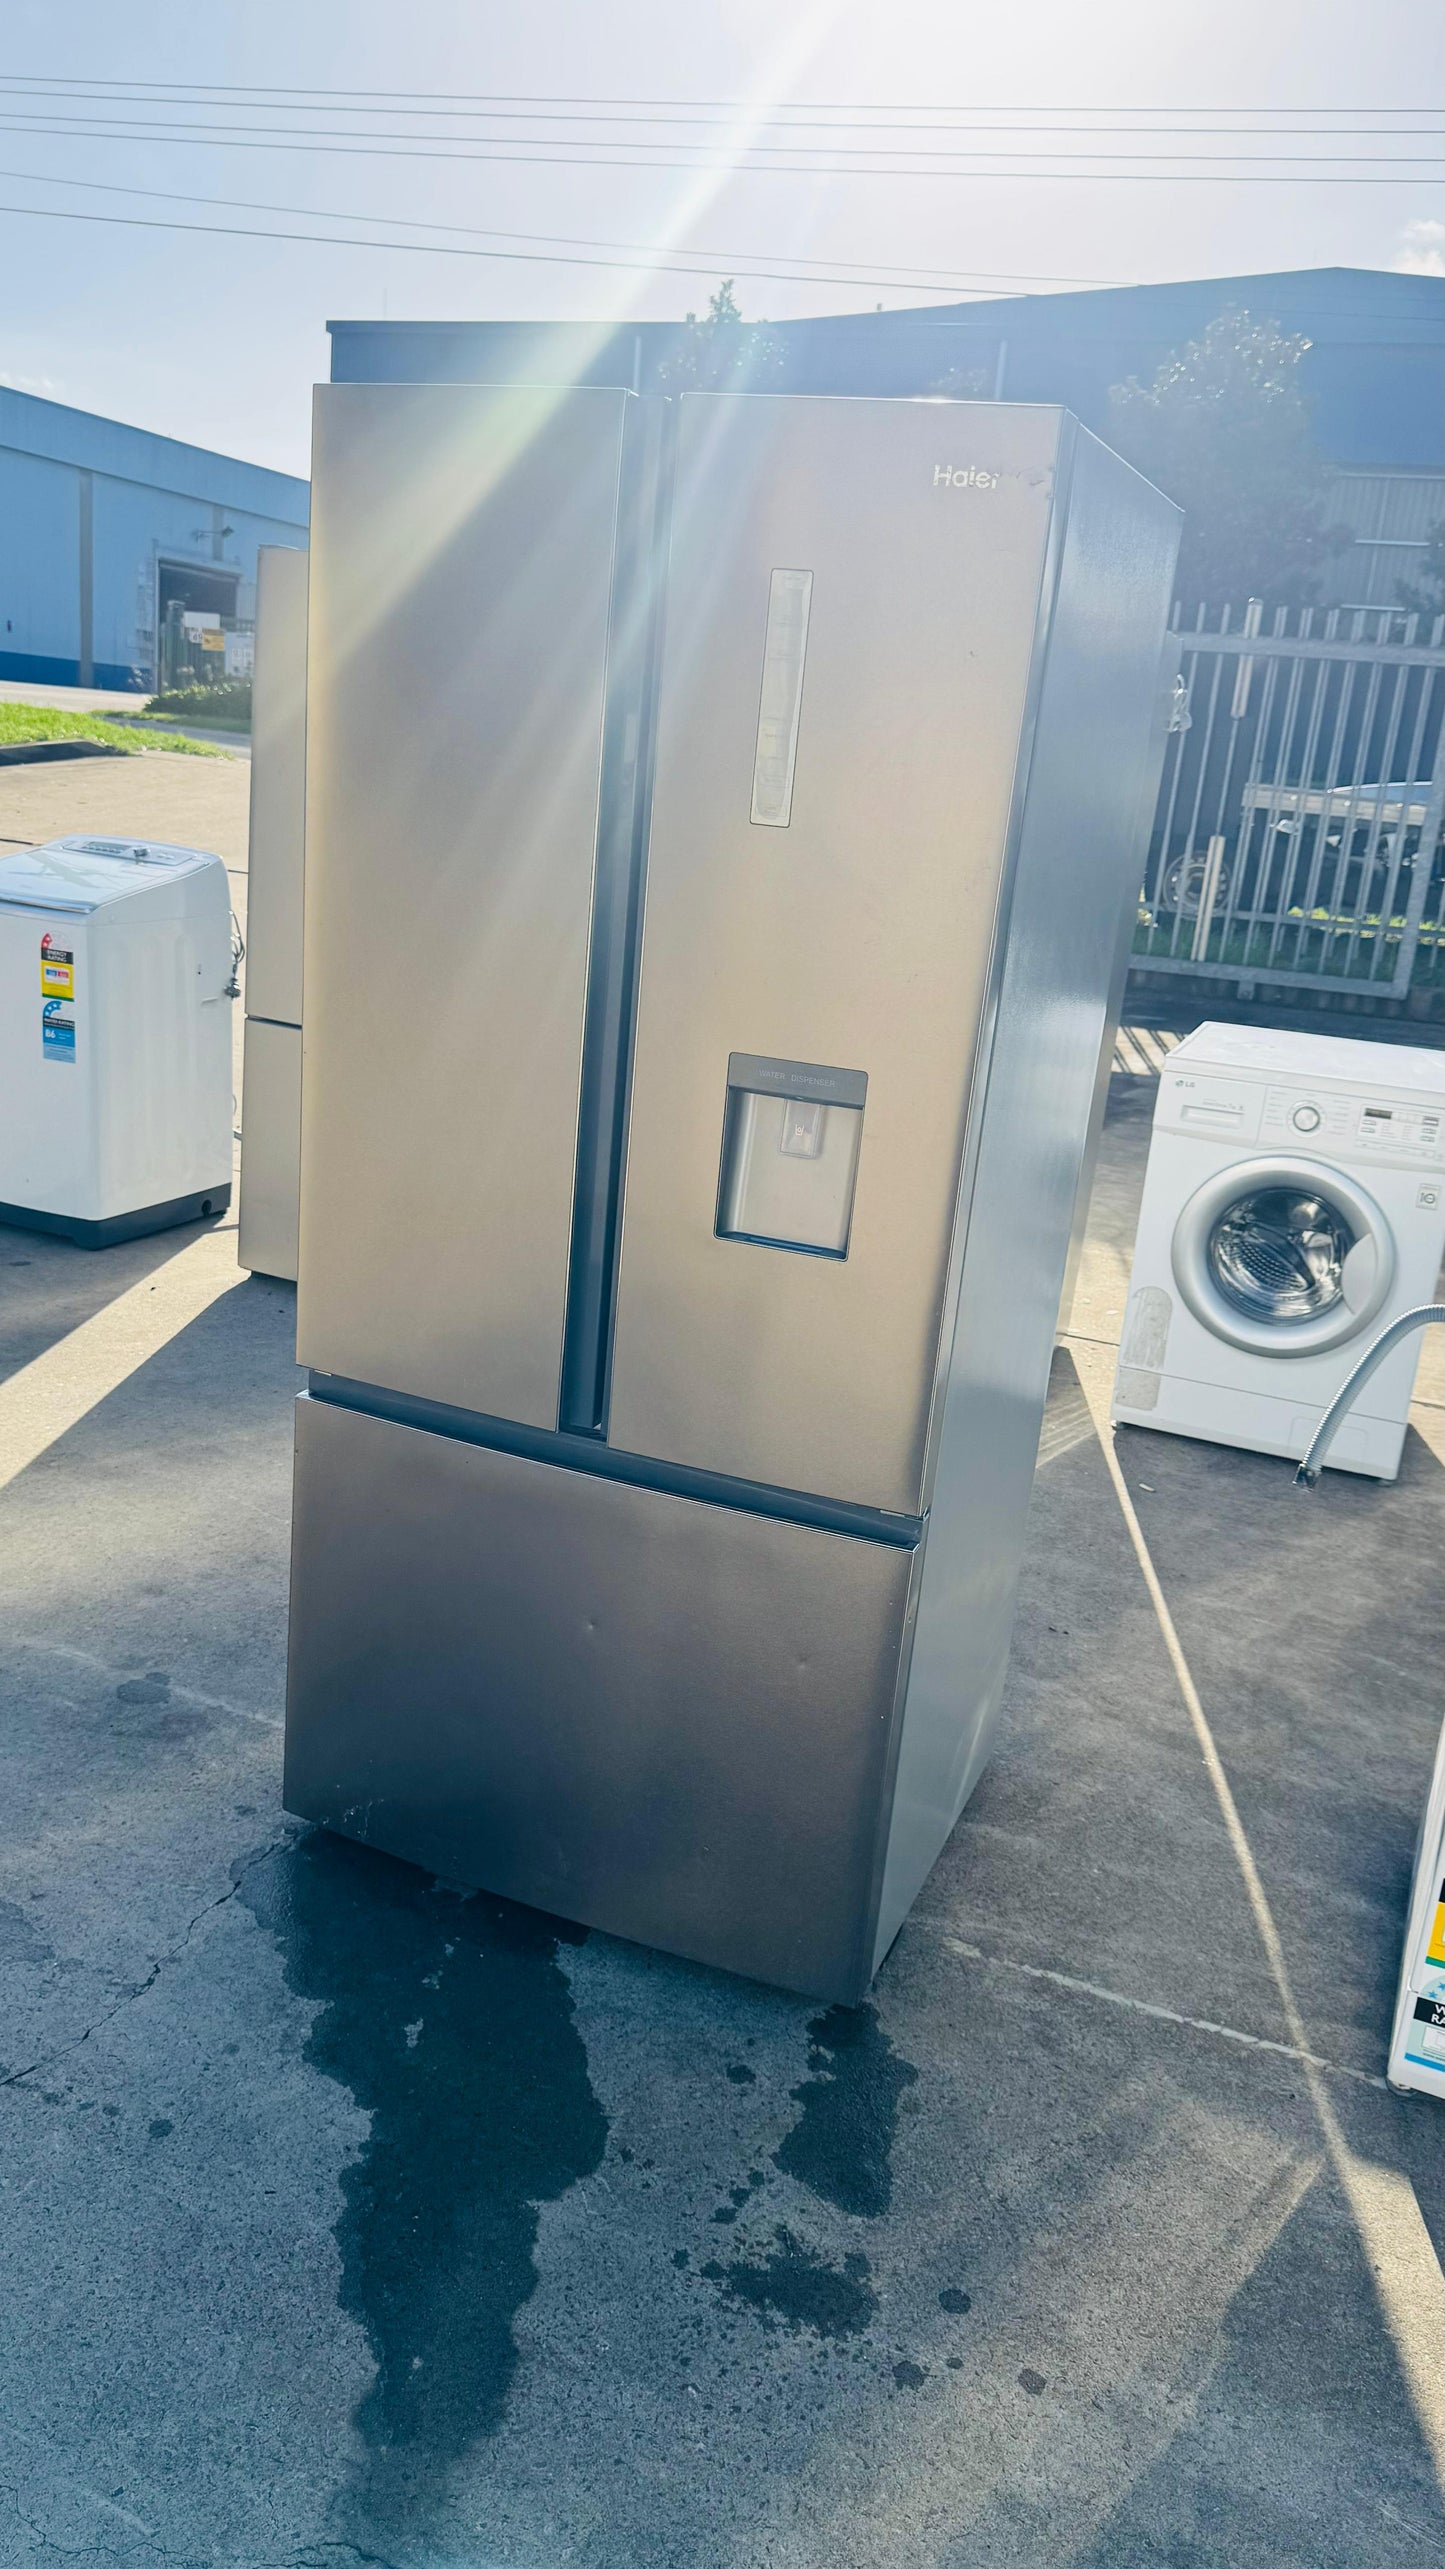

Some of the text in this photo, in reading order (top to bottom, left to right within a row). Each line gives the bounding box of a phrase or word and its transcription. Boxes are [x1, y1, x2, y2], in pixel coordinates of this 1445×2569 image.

[933, 464, 1000, 489] Haier
[759, 1069, 836, 1088] WATER DISPENSER
